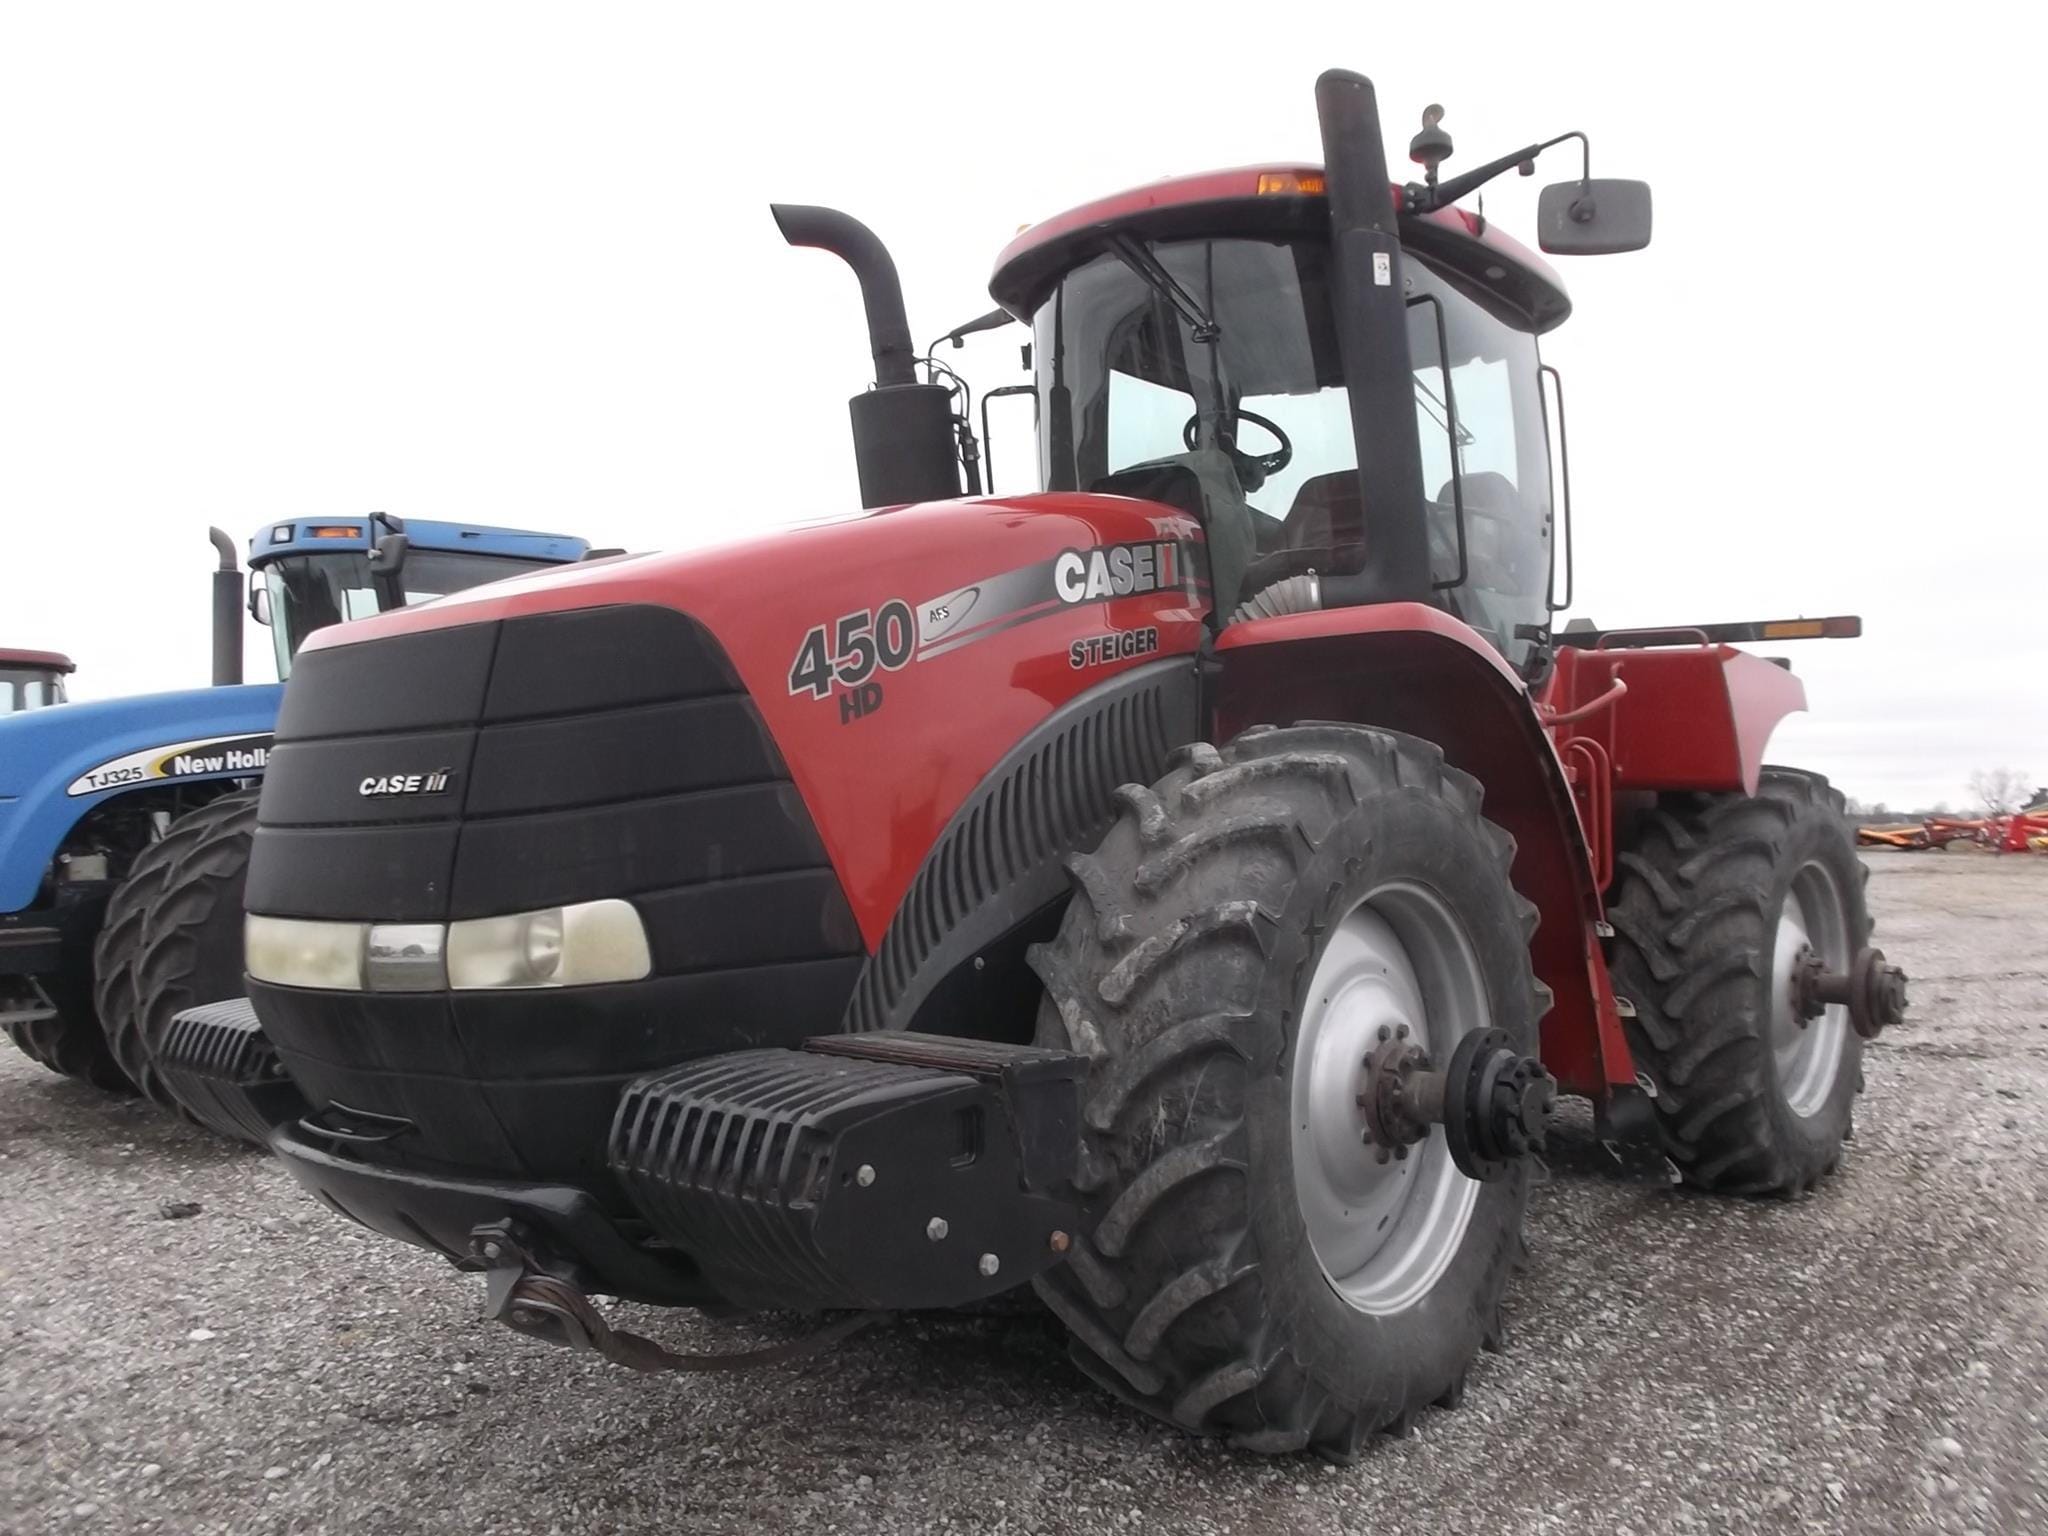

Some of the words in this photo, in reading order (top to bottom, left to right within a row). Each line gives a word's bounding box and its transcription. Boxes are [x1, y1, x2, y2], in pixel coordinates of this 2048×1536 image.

[1055, 546, 1154, 603] CASE
[929, 606, 950, 623] AFS
[788, 598, 915, 701] 450
[1069, 626, 1158, 670] STEIGER
[839, 682, 883, 725] HD
[86, 767, 143, 788] TJ325
[175, 755, 223, 775] New
[360, 775, 422, 795] CASE
